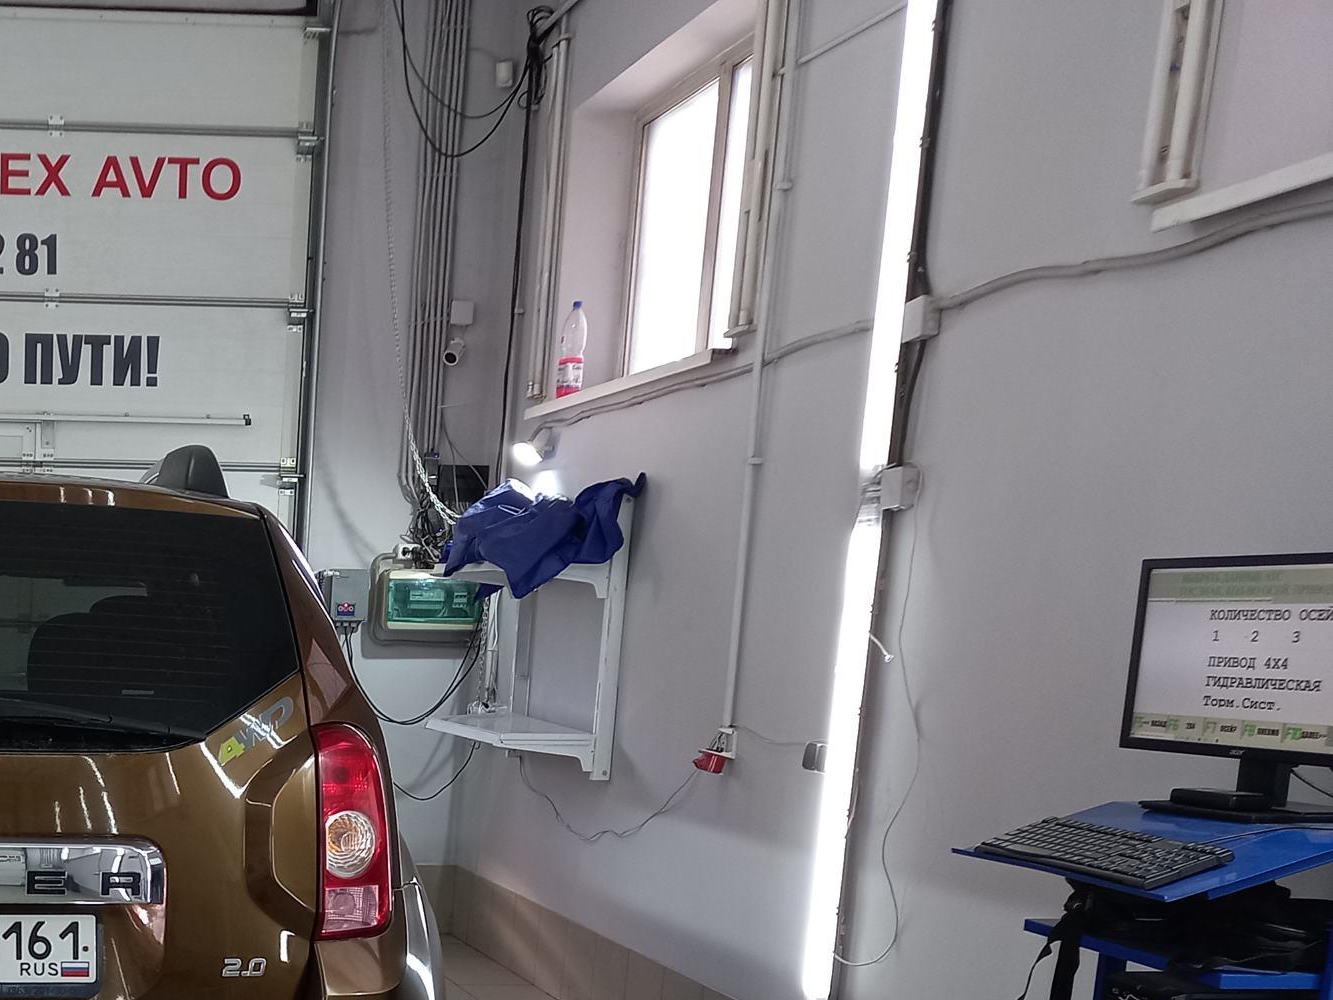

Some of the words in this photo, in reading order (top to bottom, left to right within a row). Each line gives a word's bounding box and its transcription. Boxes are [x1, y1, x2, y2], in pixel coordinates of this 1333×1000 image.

[91, 155, 242, 201] AVTO
[15, 233, 59, 276] 81
[23, 333, 161, 387] ПУТИ!
[1209, 608, 1292, 621] КОЛИЧЕСТВО
[1212, 630, 1220, 642] 1
[1251, 630, 1259, 643] 2
[1292, 630, 1301, 644] 3
[1207, 656, 1257, 670] ПРИВОД
[1205, 676, 1323, 692] ГИДРАВЛИЧЕСКАЯ
[2, 921, 80, 962] 161
[19, 963, 59, 977] RUS
[221, 957, 267, 977] 2.0
